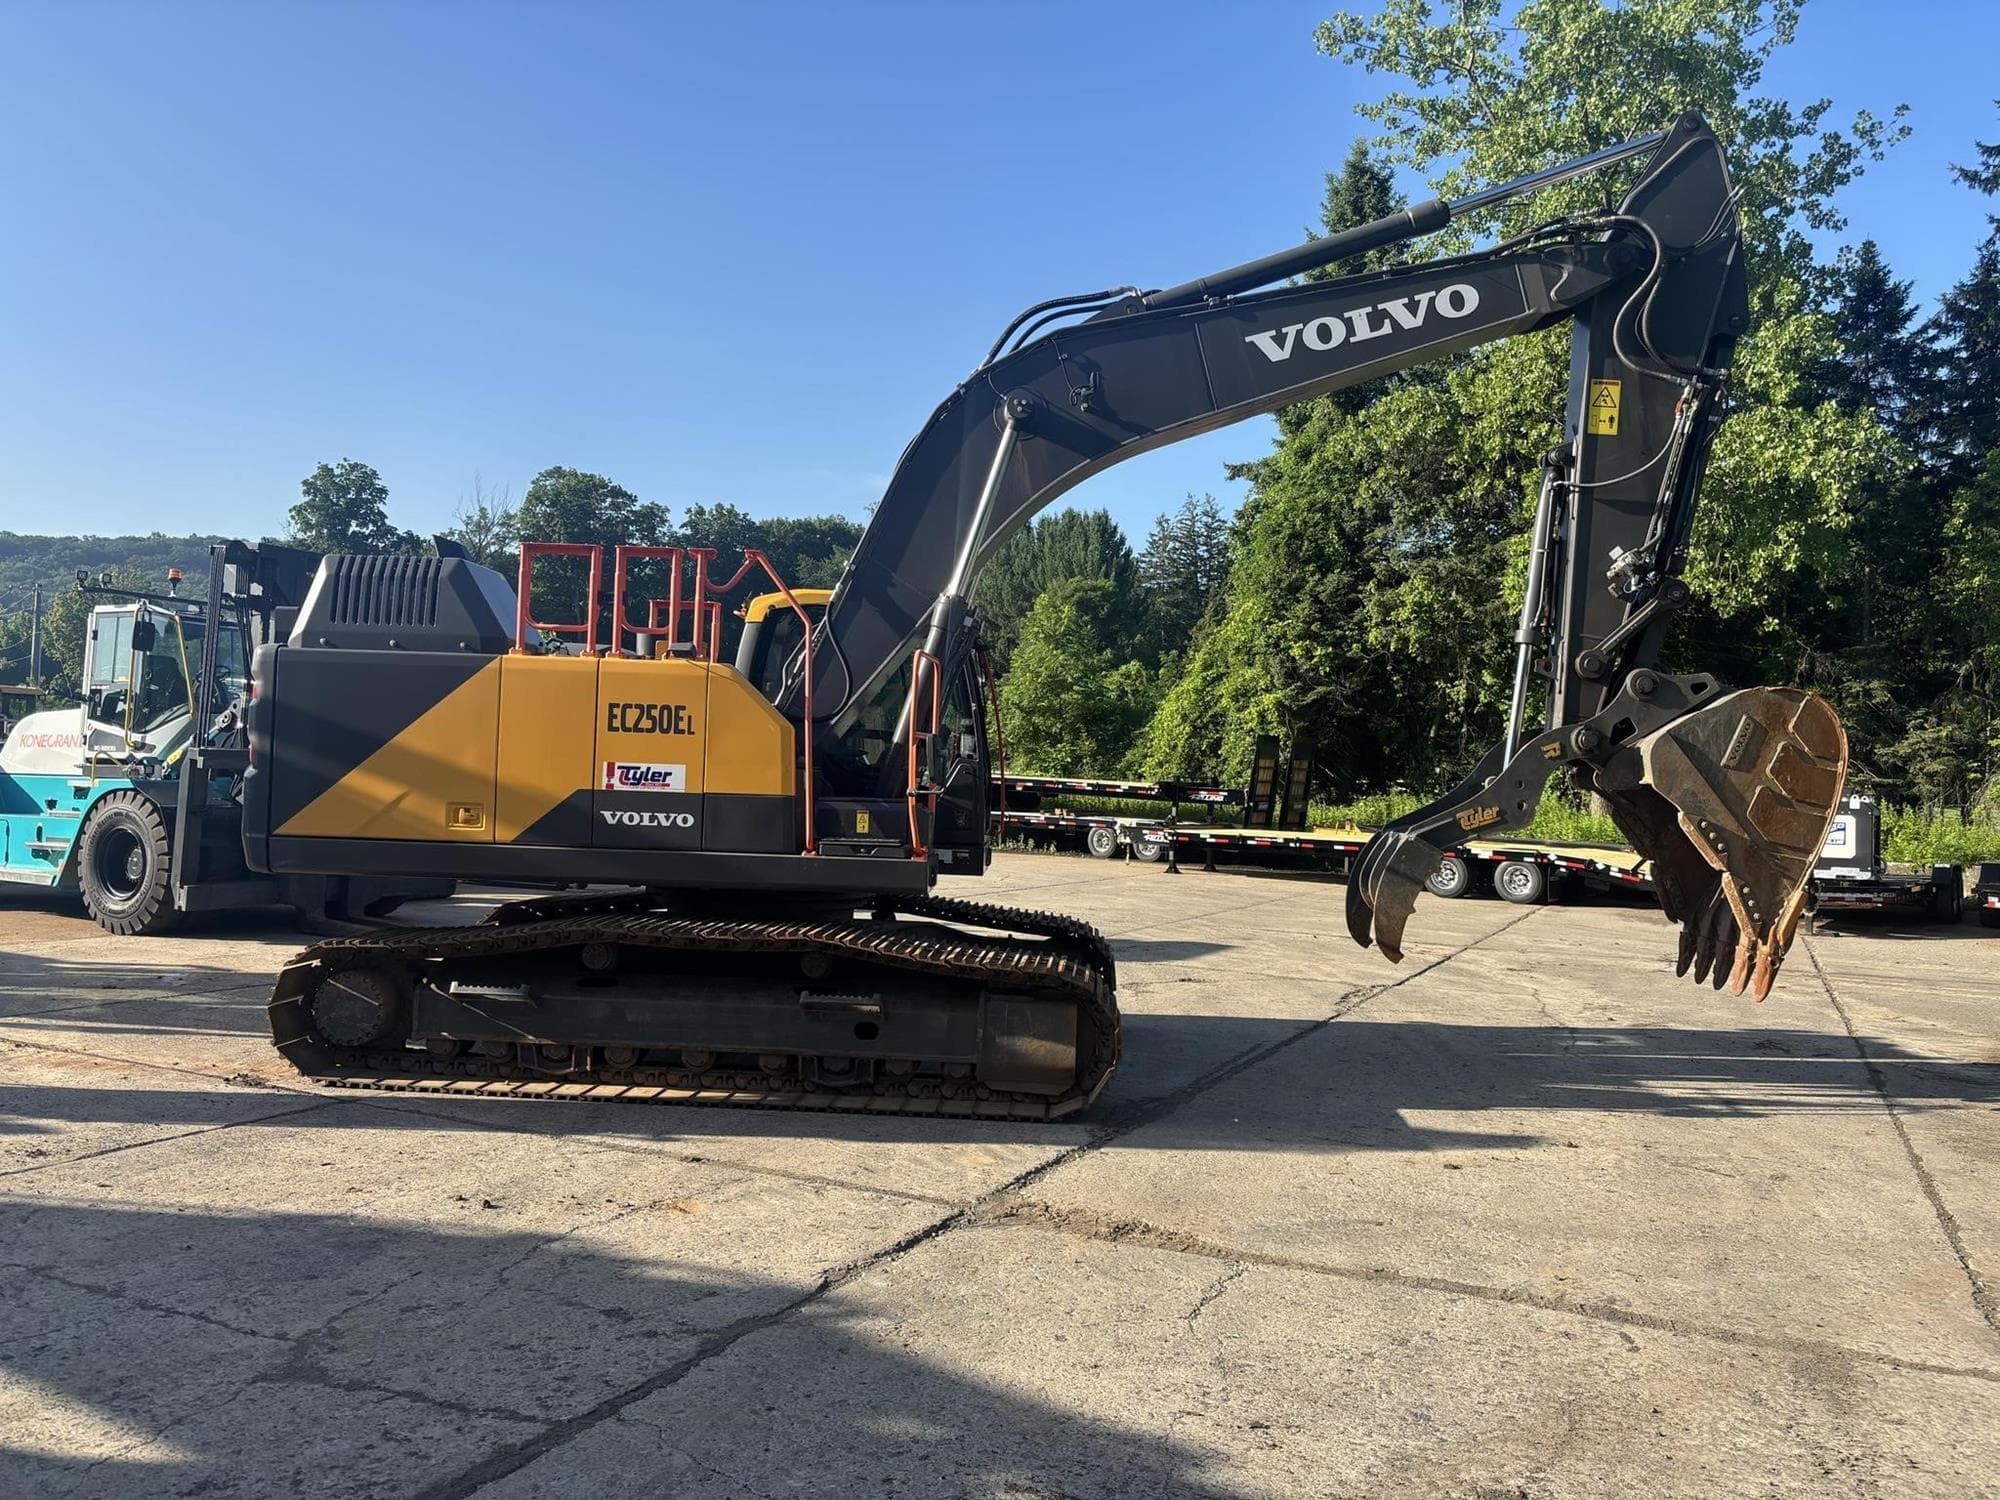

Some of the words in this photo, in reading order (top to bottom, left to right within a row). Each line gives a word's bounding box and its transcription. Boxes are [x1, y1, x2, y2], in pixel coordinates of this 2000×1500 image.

[1244, 283, 1480, 363] VOLVO
[607, 702, 695, 735] EC250EL
[617, 766, 673, 786] Tyler
[600, 810, 695, 828] VOLVO
[1456, 806, 1500, 829] Tyler
